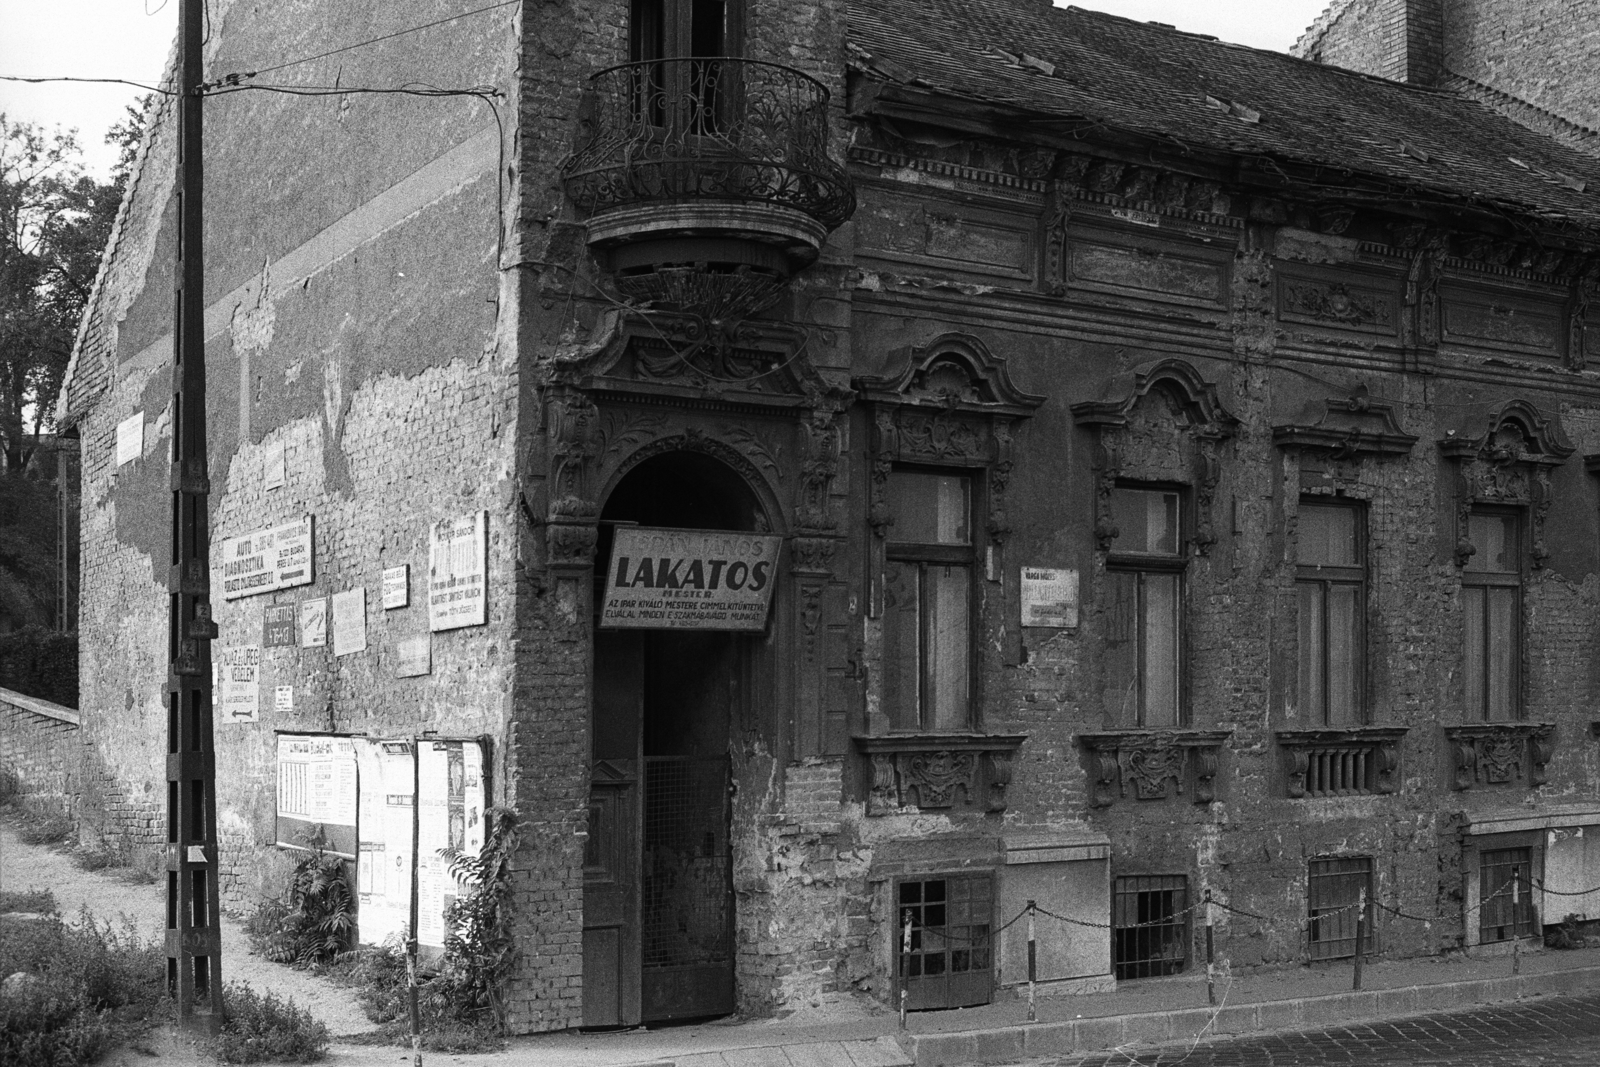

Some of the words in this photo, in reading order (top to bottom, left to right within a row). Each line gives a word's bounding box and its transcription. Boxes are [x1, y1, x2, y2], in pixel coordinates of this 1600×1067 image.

[456, 525, 475, 538] SÁNDOR
[236, 537, 252, 557] AUTÓ
[702, 536, 764, 558] JÁNOS
[224, 555, 264, 577] DIAGNOSZTIKA
[615, 557, 770, 592] LAKATOS
[200, 607, 207, 615] Z
[608, 599, 620, 608] AZ
[620, 600, 636, 609] IPAR
[638, 598, 664, 609] KIVÁLÓ
[665, 601, 698, 610] MESTERE
[700, 602, 728, 611] CIMMEL
[638, 610, 665, 619] MINDEN
[667, 611, 673, 620] E
[186, 643, 192, 652] Z
[231, 667, 255, 682] VÉDELEM
